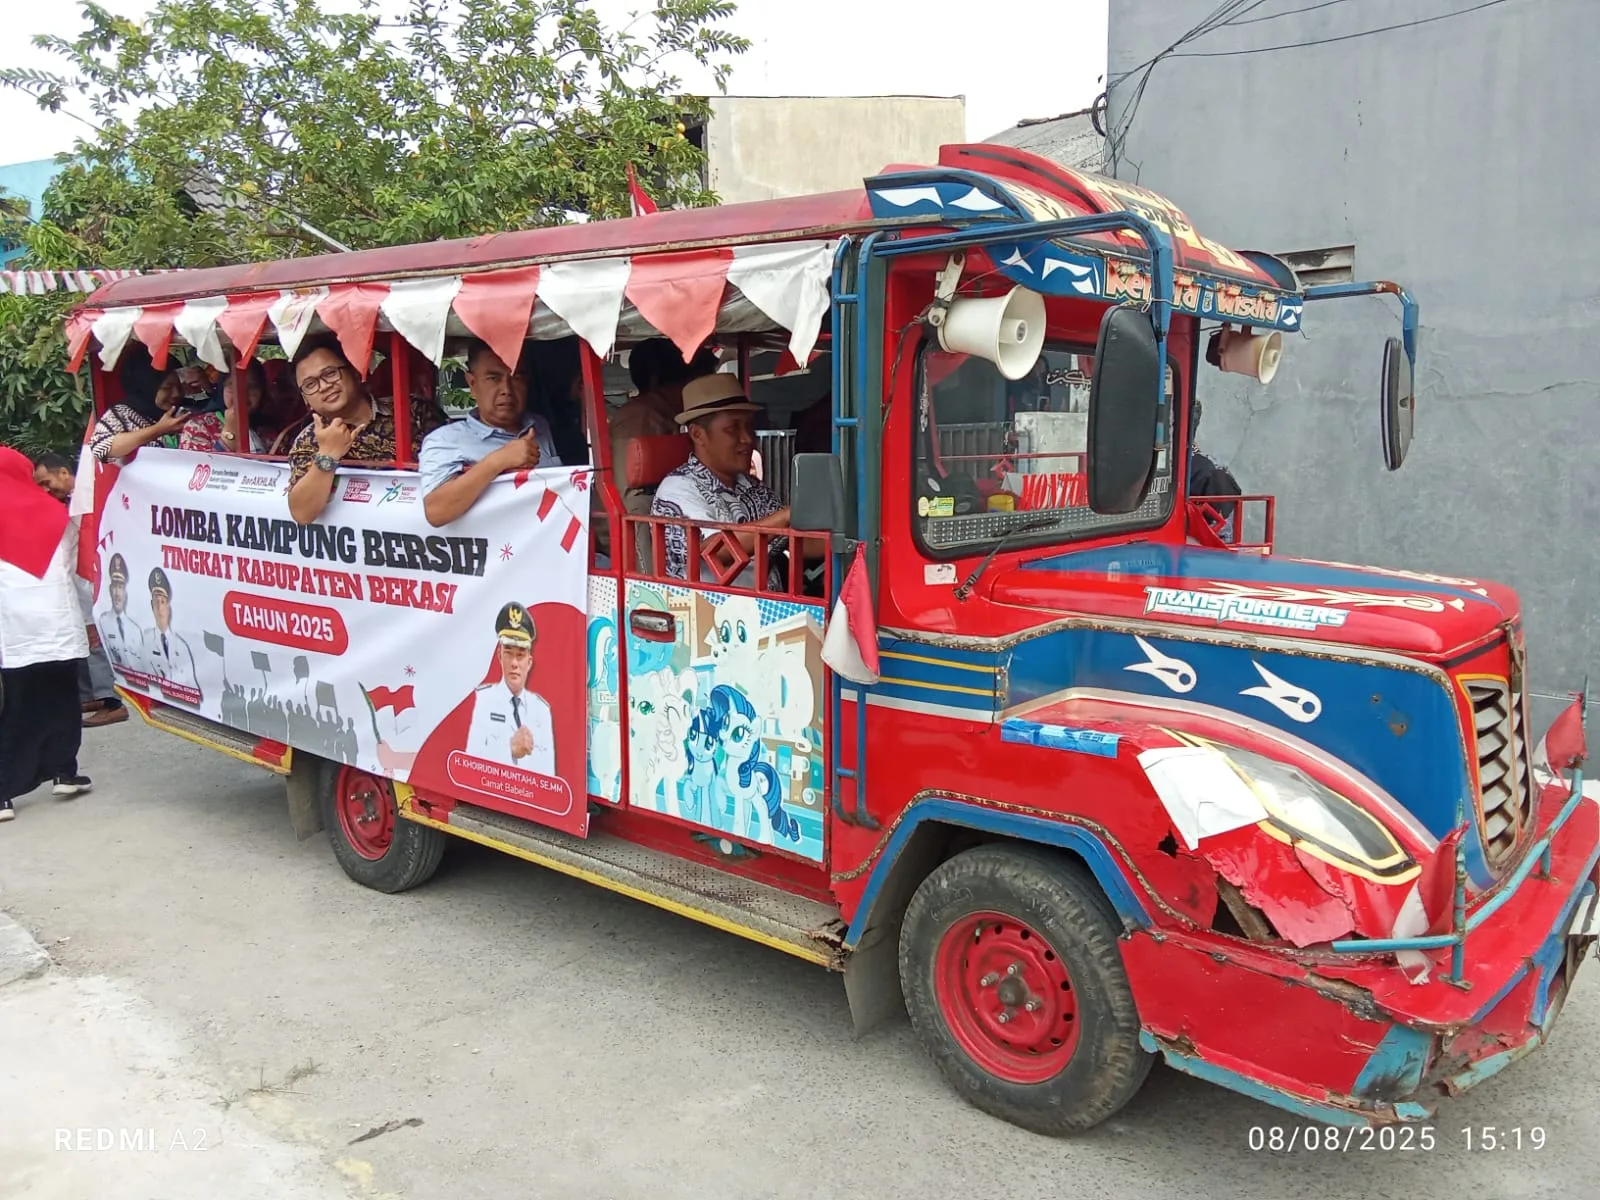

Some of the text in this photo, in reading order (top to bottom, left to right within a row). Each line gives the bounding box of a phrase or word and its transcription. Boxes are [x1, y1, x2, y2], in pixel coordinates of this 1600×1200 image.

[151, 505, 488, 577] LOMBA KAMPUNG BERSIH
[161, 544, 459, 614] TINGKAT KABUPATEN BEKASI
[232, 603, 333, 642] TAHUN 2025
[1143, 586, 1350, 626] TRANSFORMERS
[454, 757, 462, 766] H.
[463, 761, 500, 777] KHOIRUDIN
[481, 776, 534, 799] Camat Babelan
